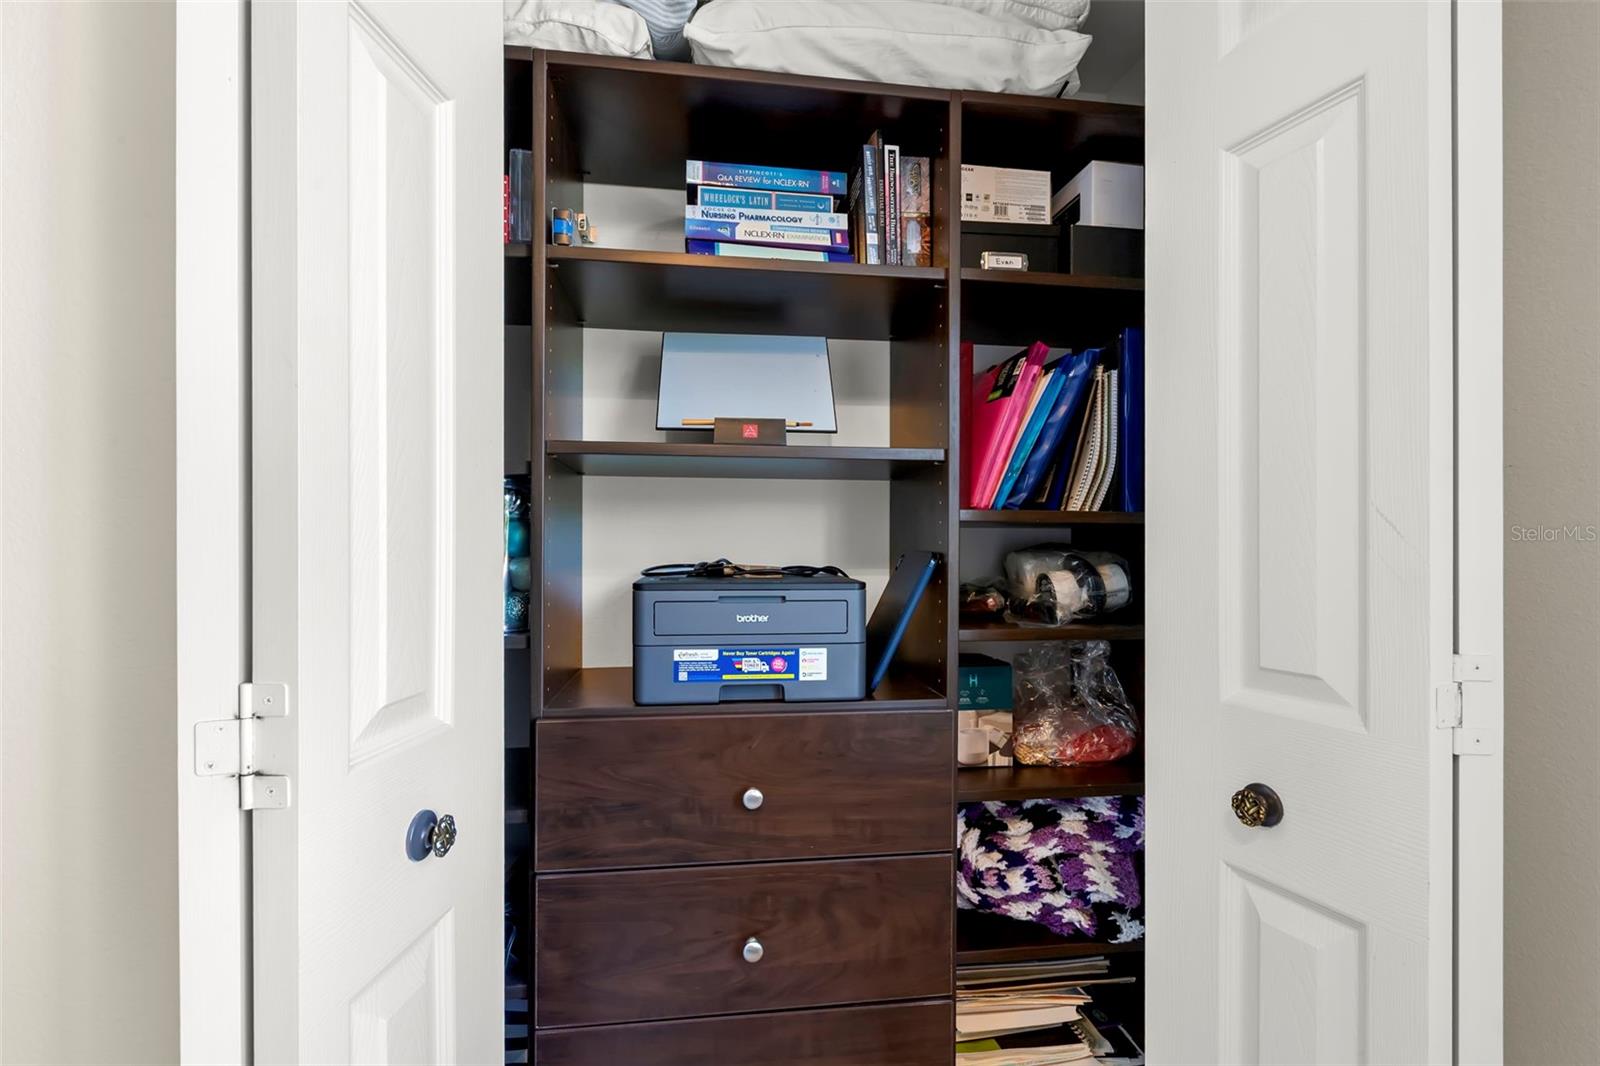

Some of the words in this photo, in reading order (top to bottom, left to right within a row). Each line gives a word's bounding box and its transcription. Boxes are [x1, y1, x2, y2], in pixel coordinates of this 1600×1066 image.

[738, 169, 783, 177] LIPPINCOTT'S
[717, 174, 734, 182] Q&A
[735, 175, 761, 184] REVIEW
[703, 193, 746, 205] WHEELOCK'S
[749, 196, 769, 206] LATIN
[701, 210, 736, 220] NURSING
[738, 212, 803, 224] PHARMACOLOGY
[995, 258, 1014, 266] Evan
[736, 614, 769, 623] brother
[969, 674, 978, 687] H
